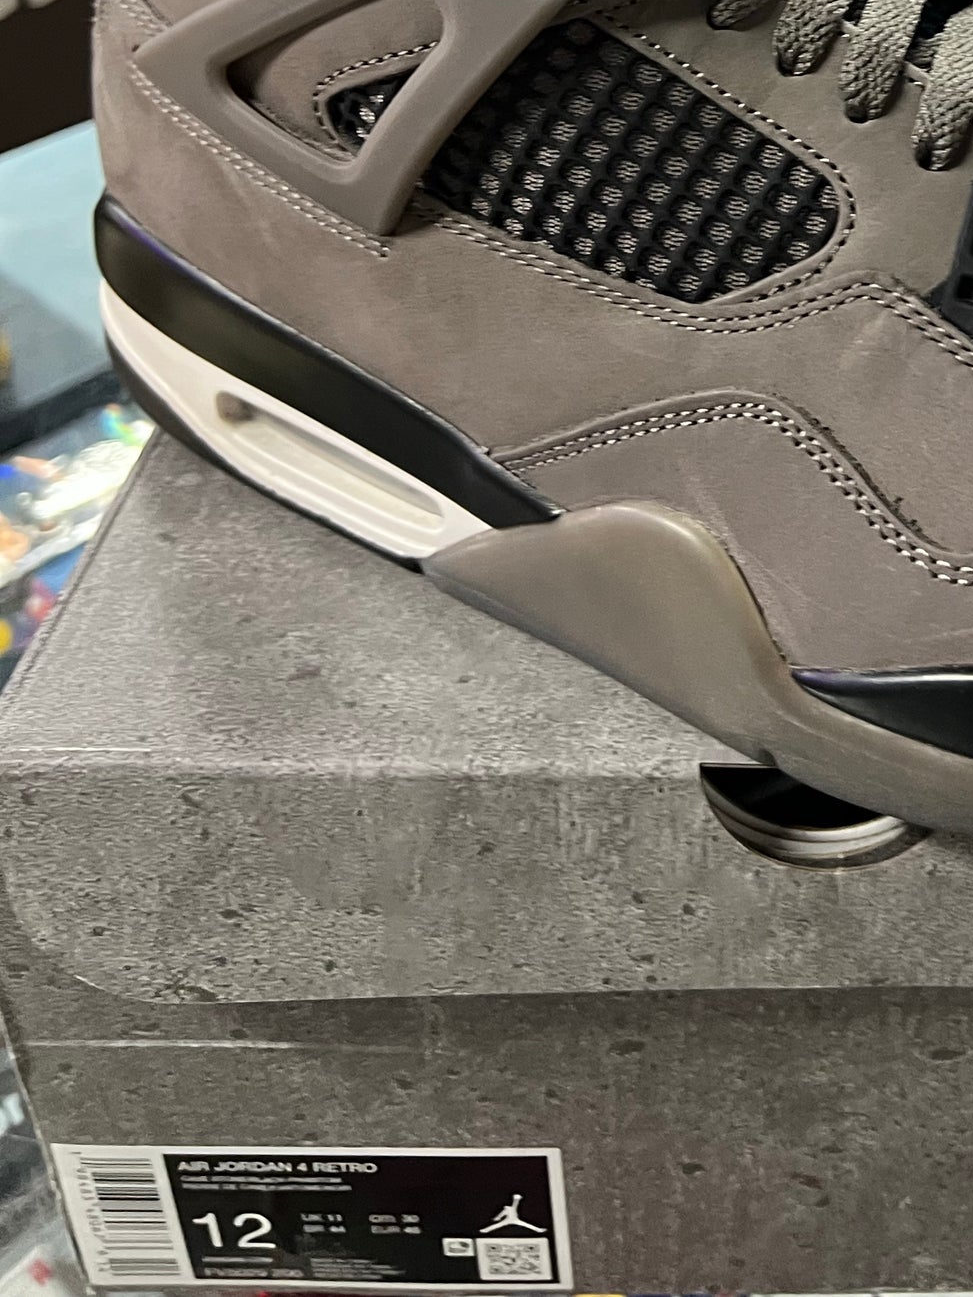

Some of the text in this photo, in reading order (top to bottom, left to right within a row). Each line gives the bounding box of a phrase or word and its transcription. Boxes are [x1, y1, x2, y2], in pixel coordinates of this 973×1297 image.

[178, 1161, 378, 1173] AIR JORDAN 4 RETRO
[192, 1212, 277, 1248] 12
